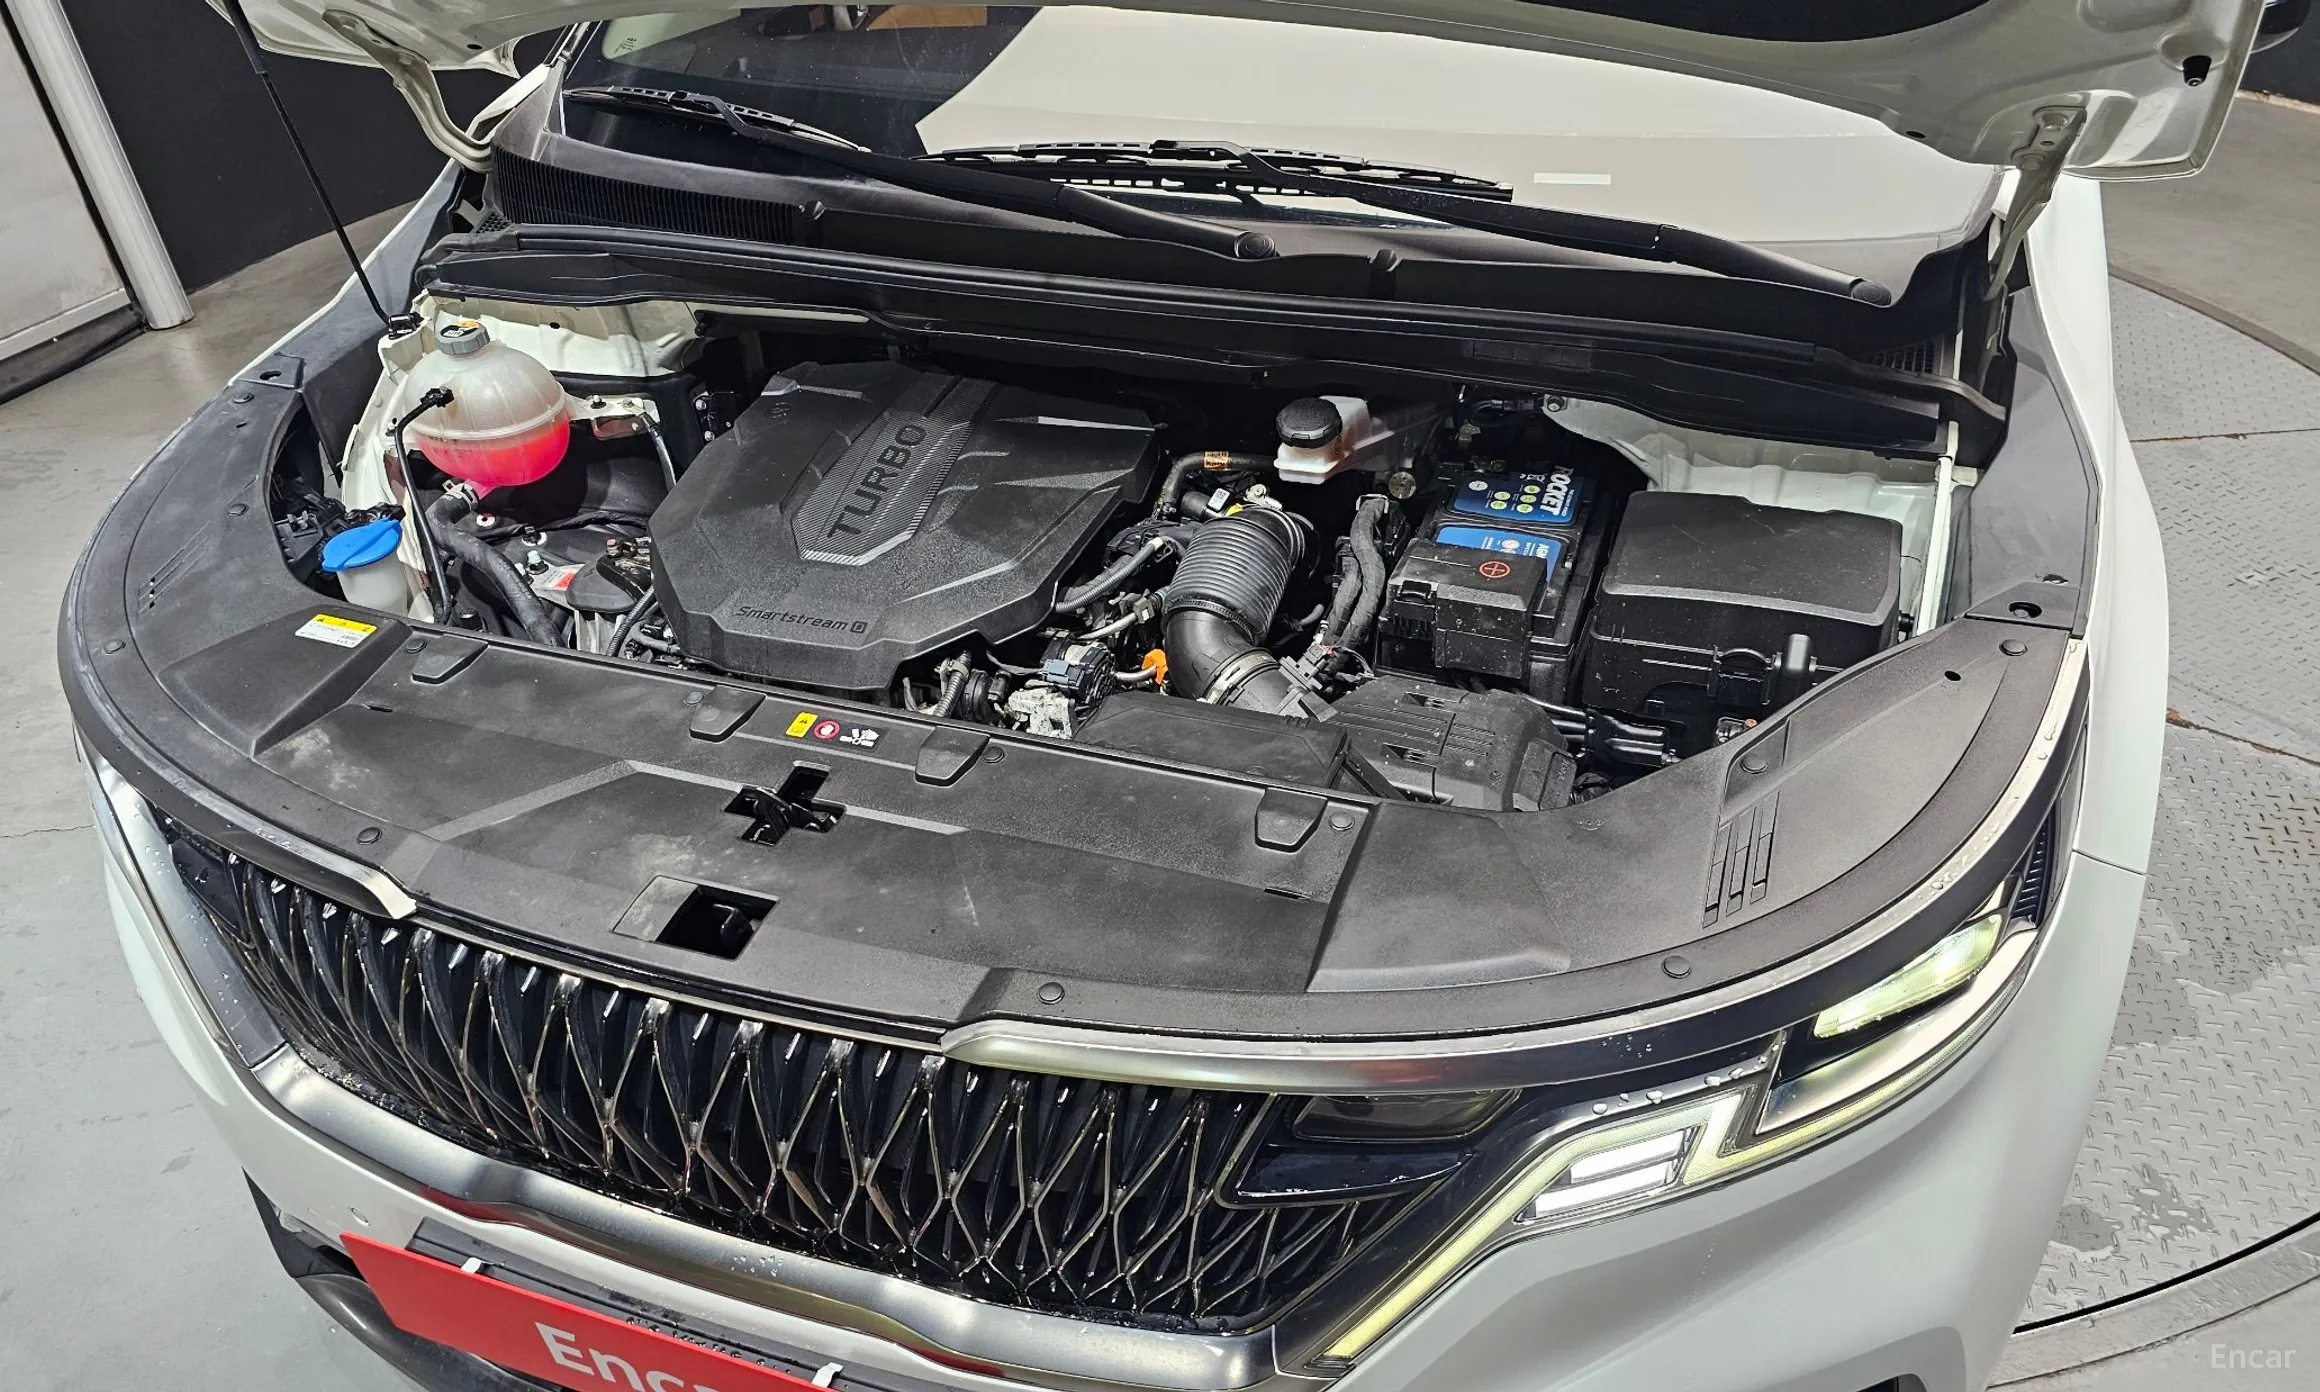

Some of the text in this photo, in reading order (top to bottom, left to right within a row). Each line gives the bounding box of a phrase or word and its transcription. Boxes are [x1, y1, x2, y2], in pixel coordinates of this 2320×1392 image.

[826, 425, 926, 538] TURBO
[1540, 465, 1574, 516] ROCKET
[735, 606, 849, 631] Smartstream
